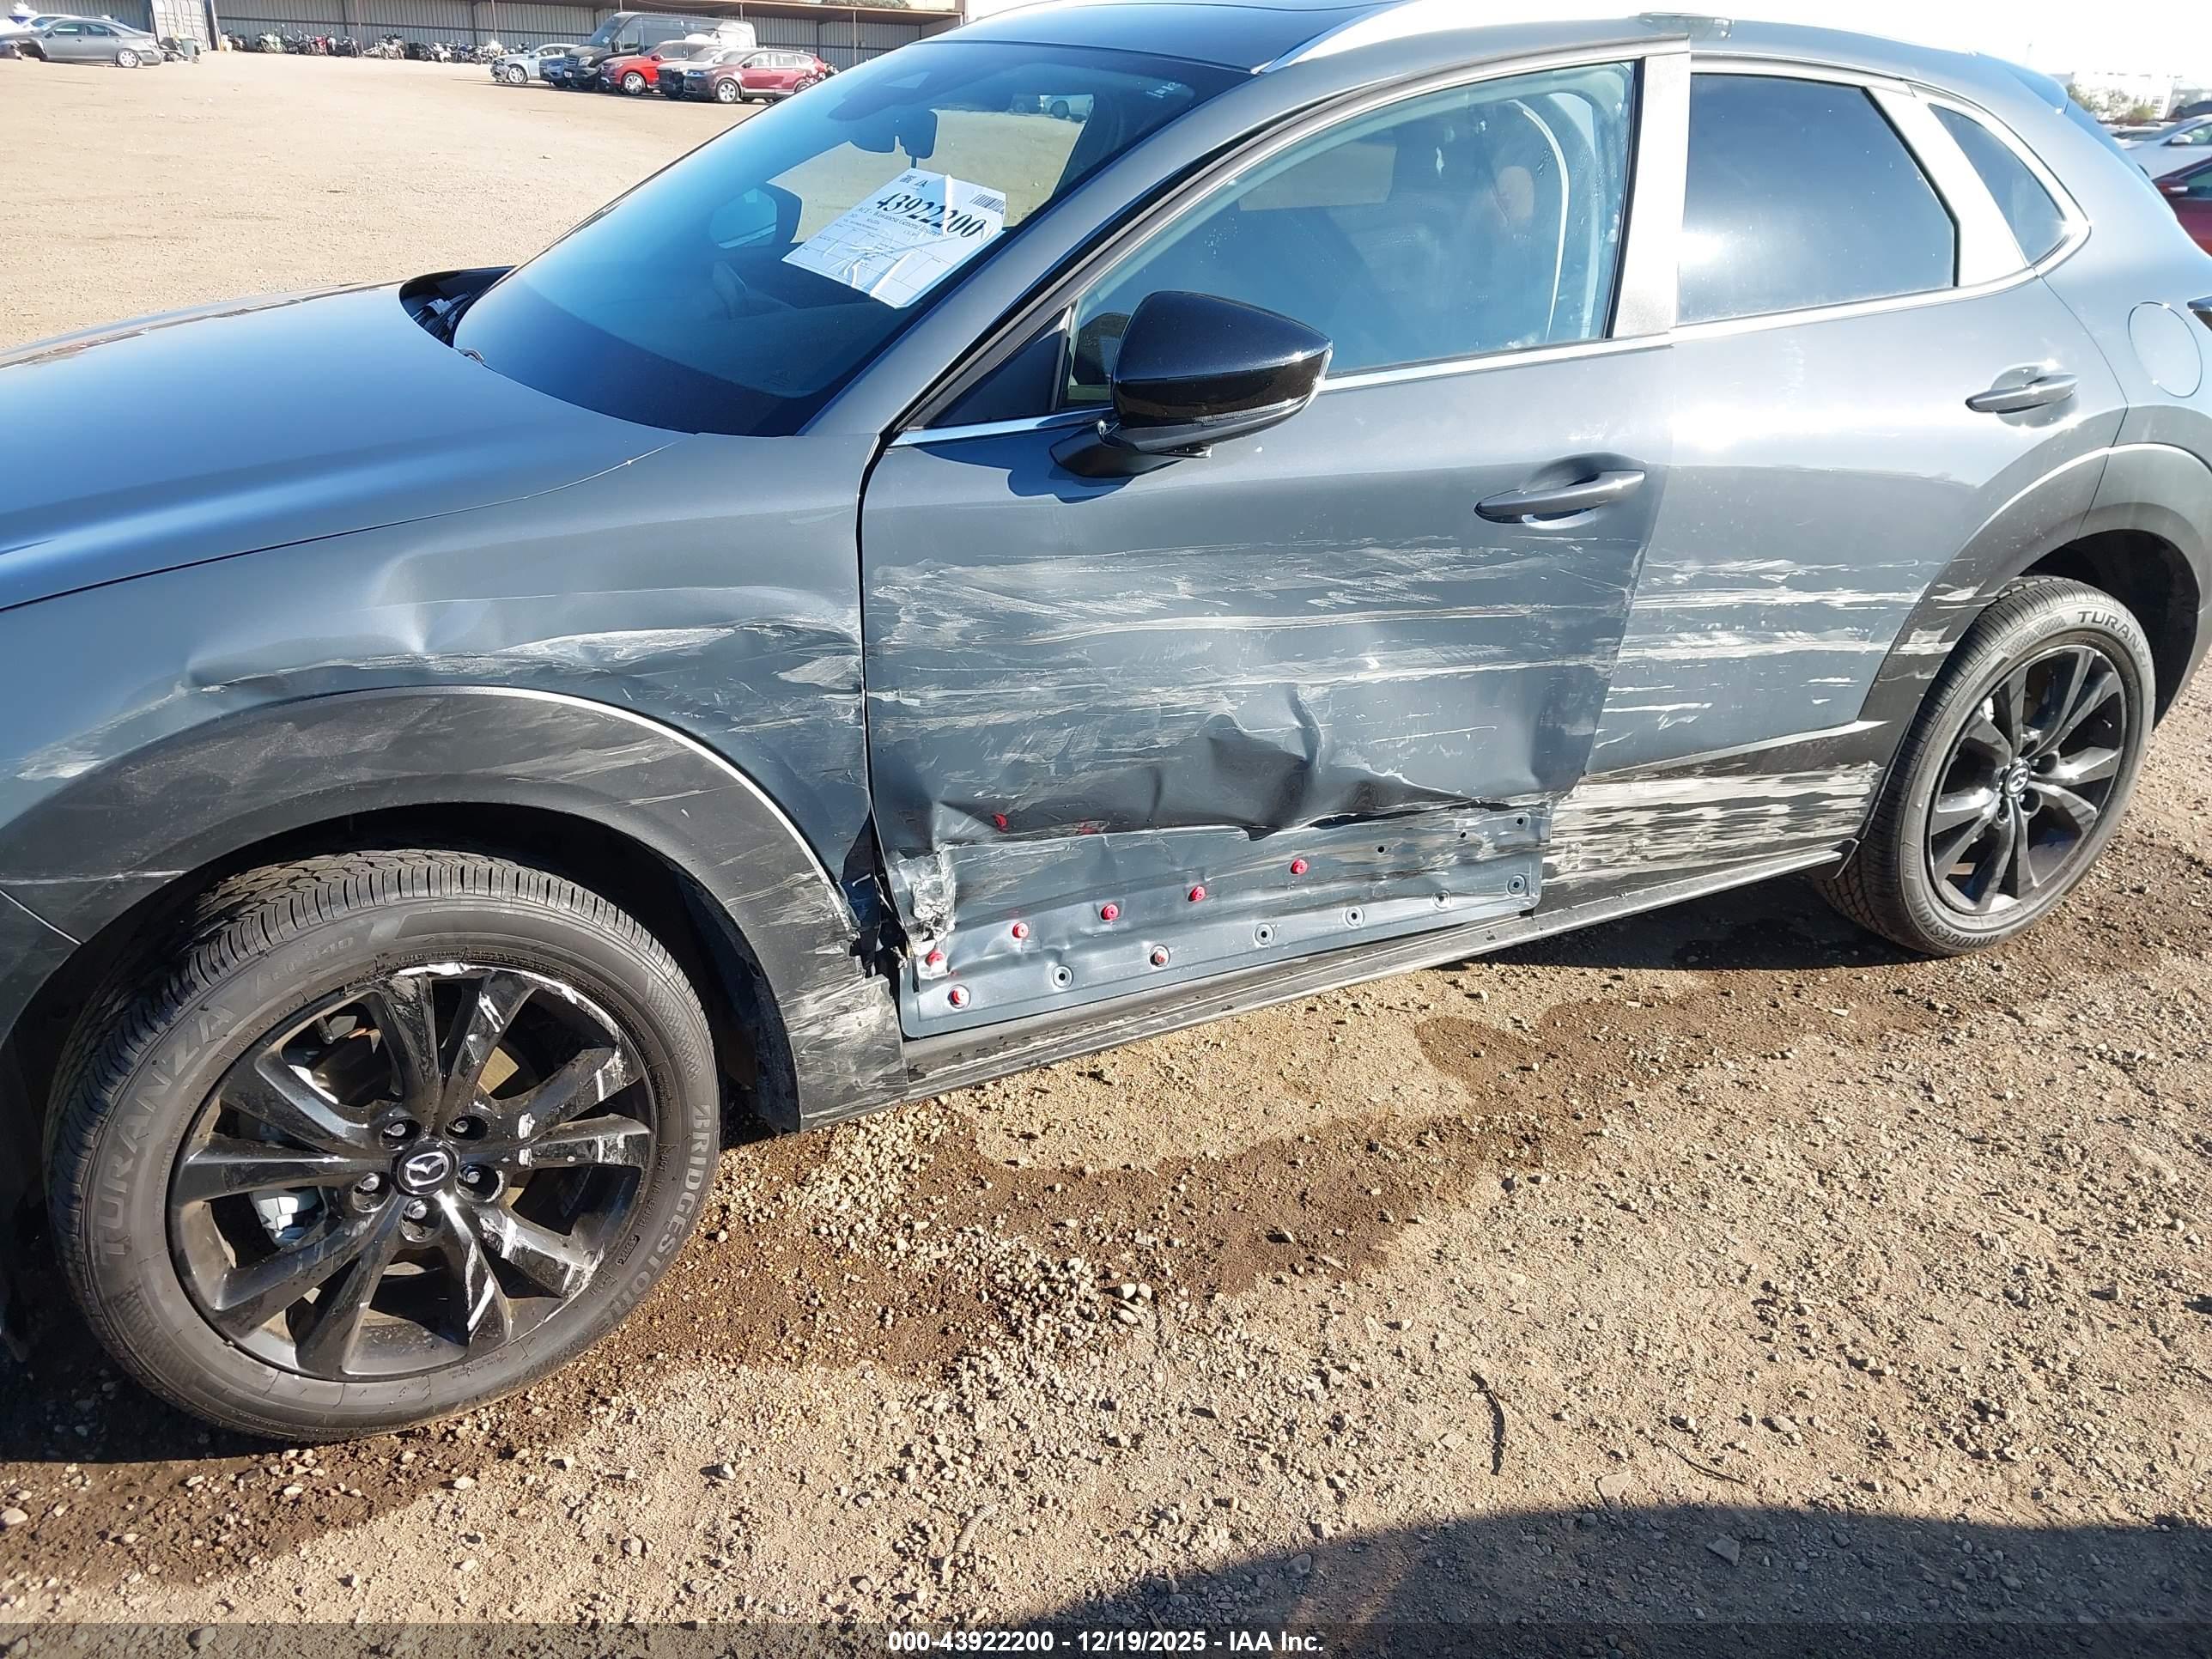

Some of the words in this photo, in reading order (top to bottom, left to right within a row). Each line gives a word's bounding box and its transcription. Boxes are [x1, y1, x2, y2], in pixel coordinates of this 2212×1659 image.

[877, 192, 987, 238] 43922200
[96, 1006, 236, 1266] TURANZA
[592, 1103, 711, 1334] BRIDGESTONE
